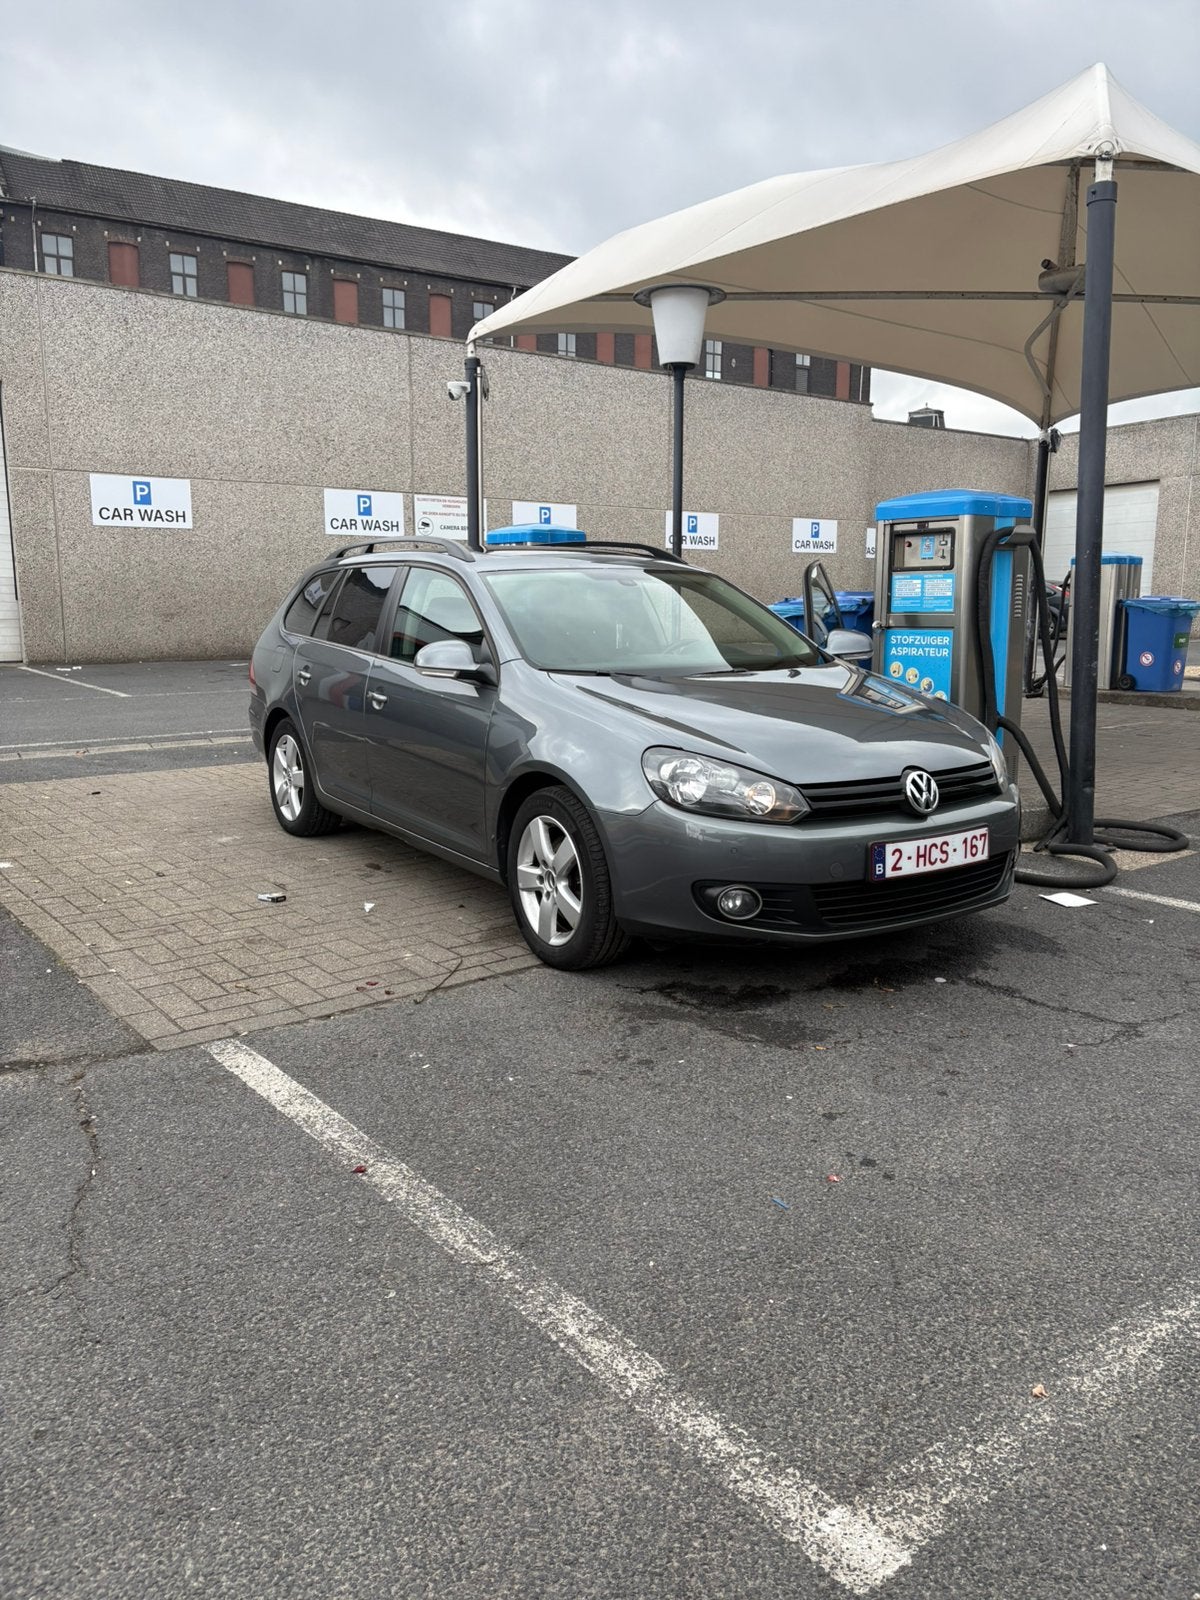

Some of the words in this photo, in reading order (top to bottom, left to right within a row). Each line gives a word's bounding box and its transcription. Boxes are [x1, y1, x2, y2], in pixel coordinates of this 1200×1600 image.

[136, 484, 149, 501] P
[360, 497, 370, 513] P
[99, 506, 133, 521] CAR
[138, 509, 186, 523] WASH
[541, 509, 550, 523] P
[330, 517, 357, 530] CAR
[361, 519, 399, 532] WASH
[690, 517, 697, 531] P
[812, 524, 819, 536] P
[668, 534, 688, 545] CR
[689, 535, 716, 546] WASH
[795, 539, 811, 549] CAR
[812, 540, 835, 550] WASH
[890, 635, 950, 645] STOFZUIGER
[890, 646, 949, 657] ASPIRATEUR
[891, 832, 988, 872] 2-HCS-167
[875, 863, 884, 875] B
